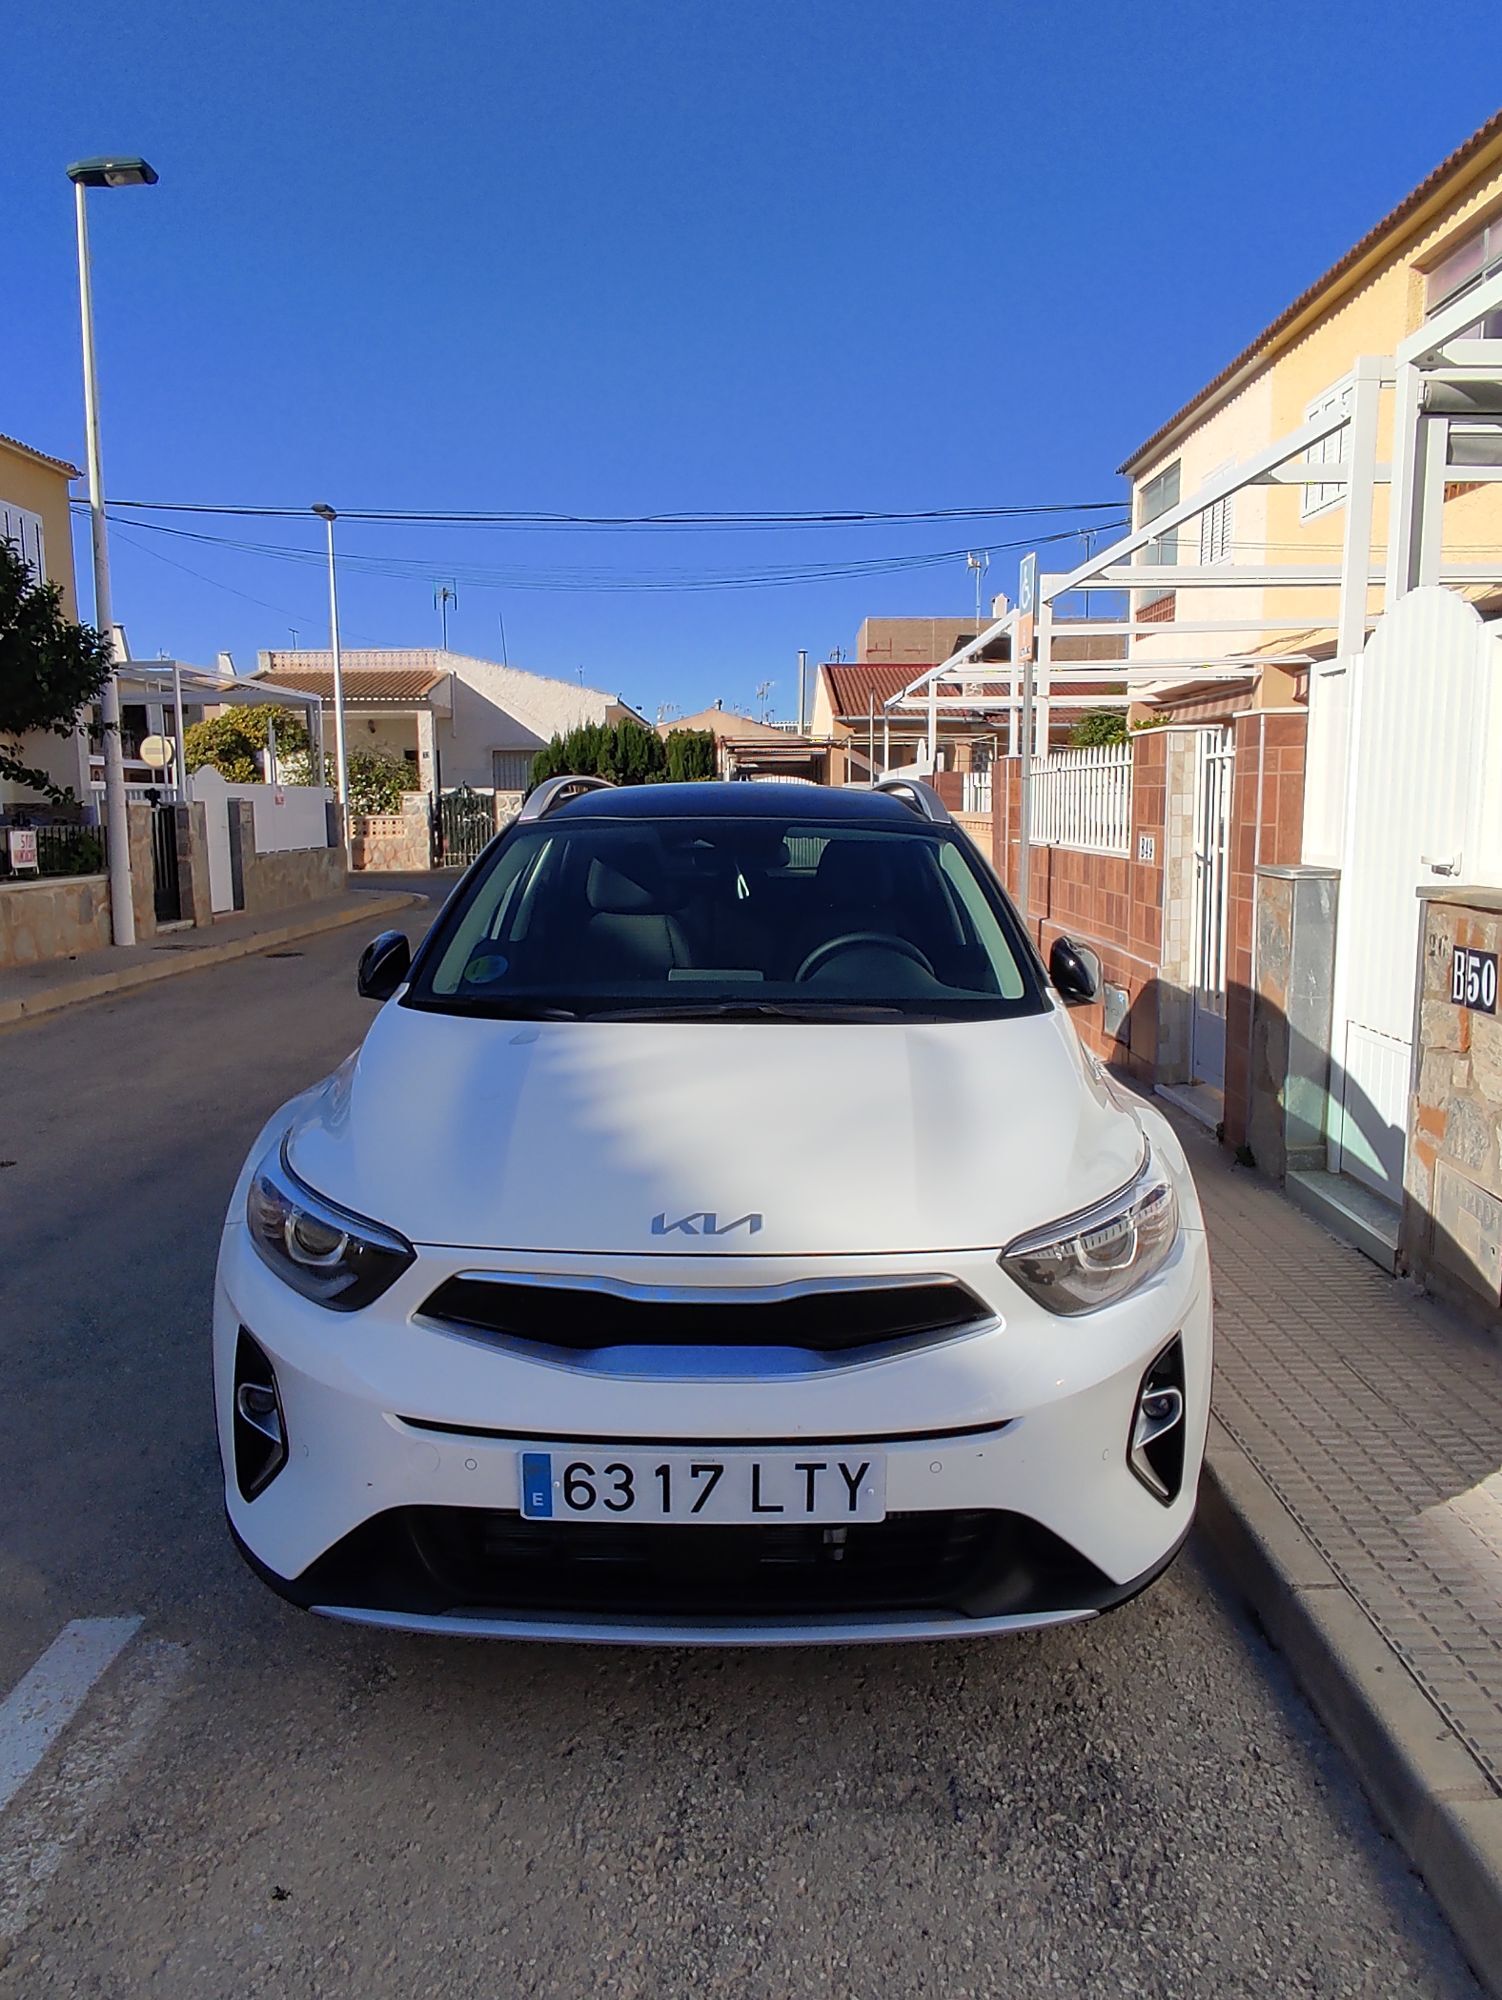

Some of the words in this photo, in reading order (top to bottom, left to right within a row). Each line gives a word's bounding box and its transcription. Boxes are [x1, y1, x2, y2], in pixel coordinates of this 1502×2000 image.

[1452, 950, 1496, 1007] B50
[651, 1212, 763, 1235] KIA
[532, 1492, 544, 1506] E
[563, 1462, 724, 1513] 6317
[751, 1462, 871, 1513] LTY
